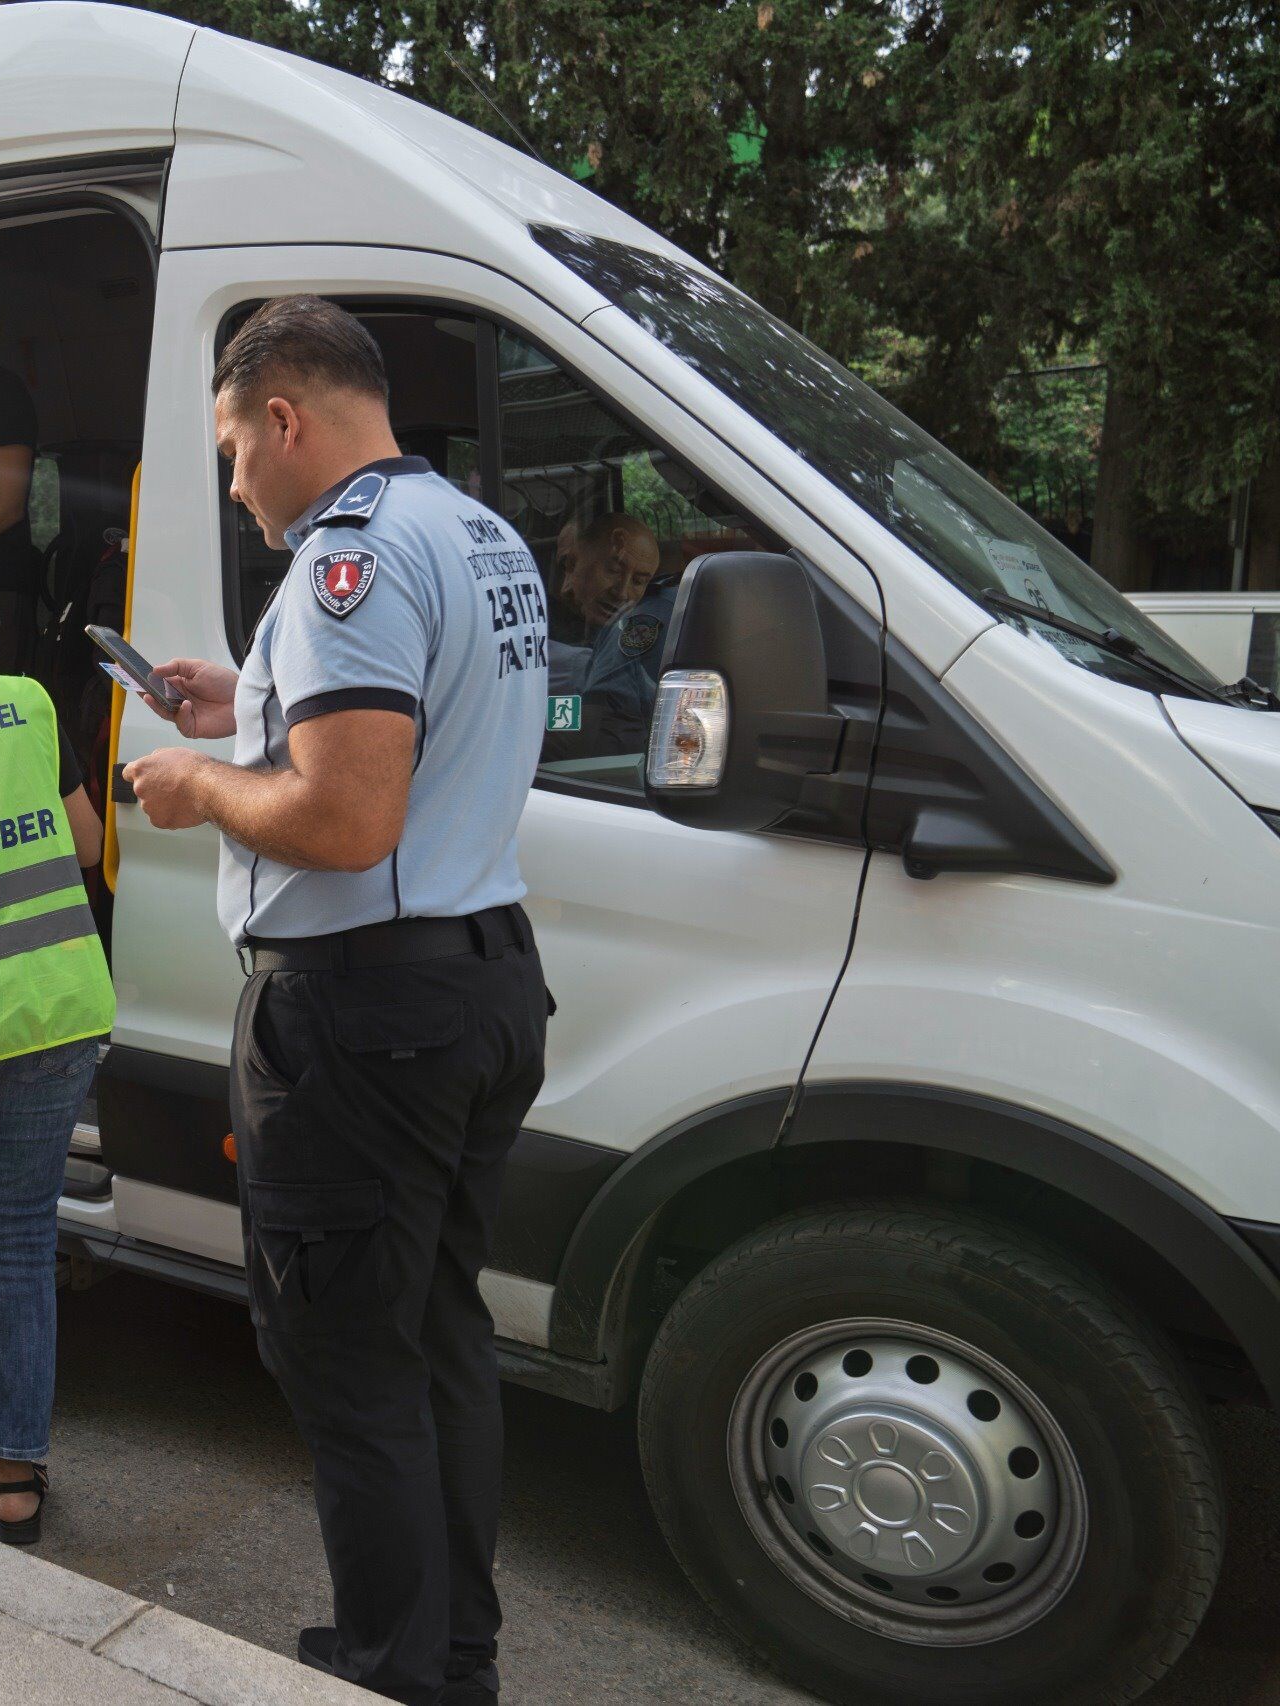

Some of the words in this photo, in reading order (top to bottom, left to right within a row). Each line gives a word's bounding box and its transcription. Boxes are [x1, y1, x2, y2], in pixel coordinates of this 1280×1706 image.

[457, 514, 507, 544] İZMİR
[329, 552, 361, 564] İZMİR
[467, 547, 539, 581] BYKŞEHİR
[316, 565, 341, 609] BÜYÜKŞEHİR
[342, 561, 372, 608] BELEDİYESİ
[486, 583, 546, 632] ZBITA
[497, 626, 548, 680] TAFİK
